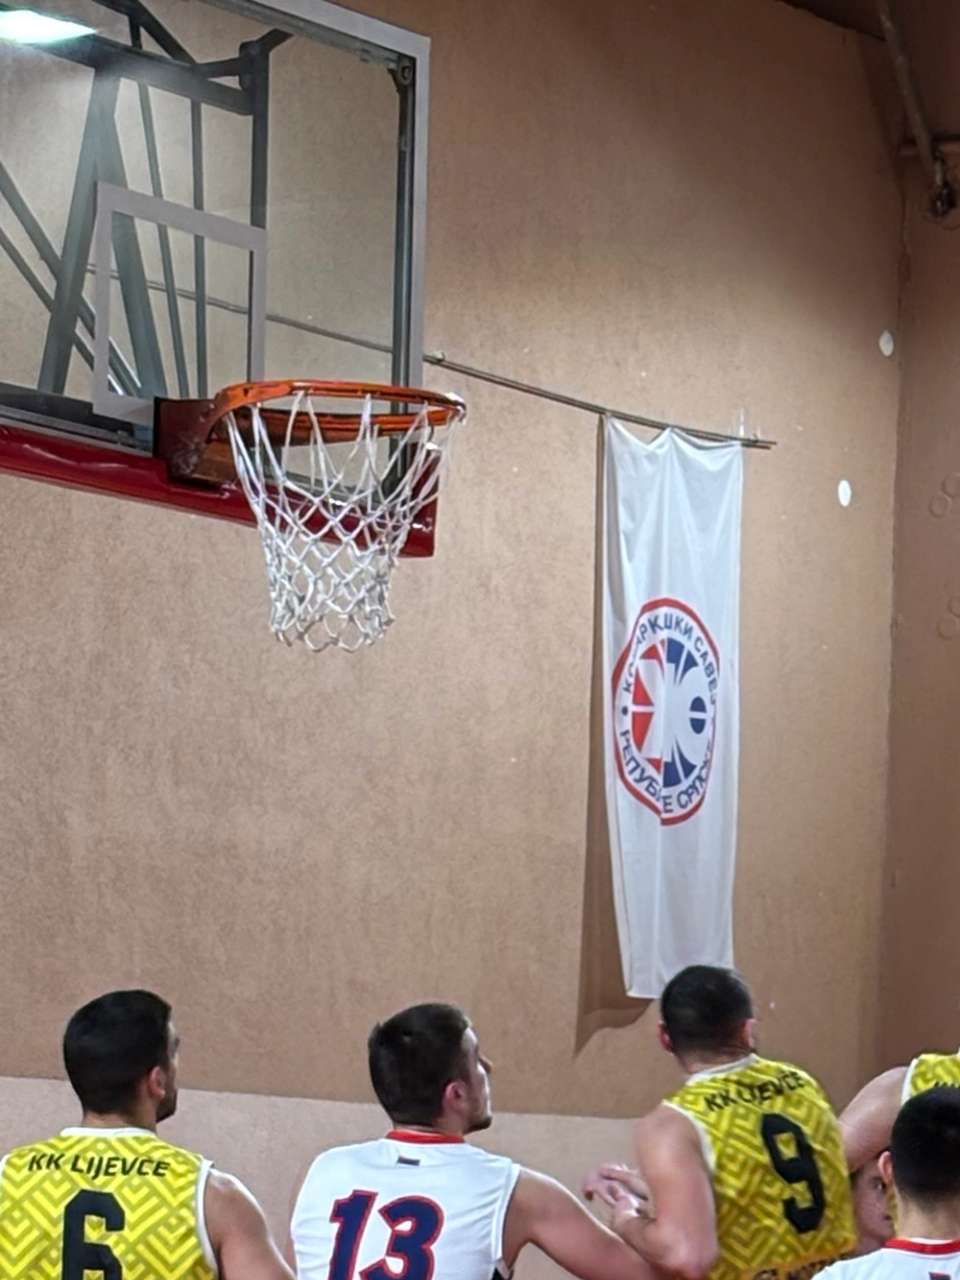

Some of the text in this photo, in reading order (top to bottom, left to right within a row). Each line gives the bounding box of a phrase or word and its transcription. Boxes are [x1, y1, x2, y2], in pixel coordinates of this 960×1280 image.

[28, 1153, 171, 1181] KK LIJEVCE
[760, 1113, 826, 1234] 9
